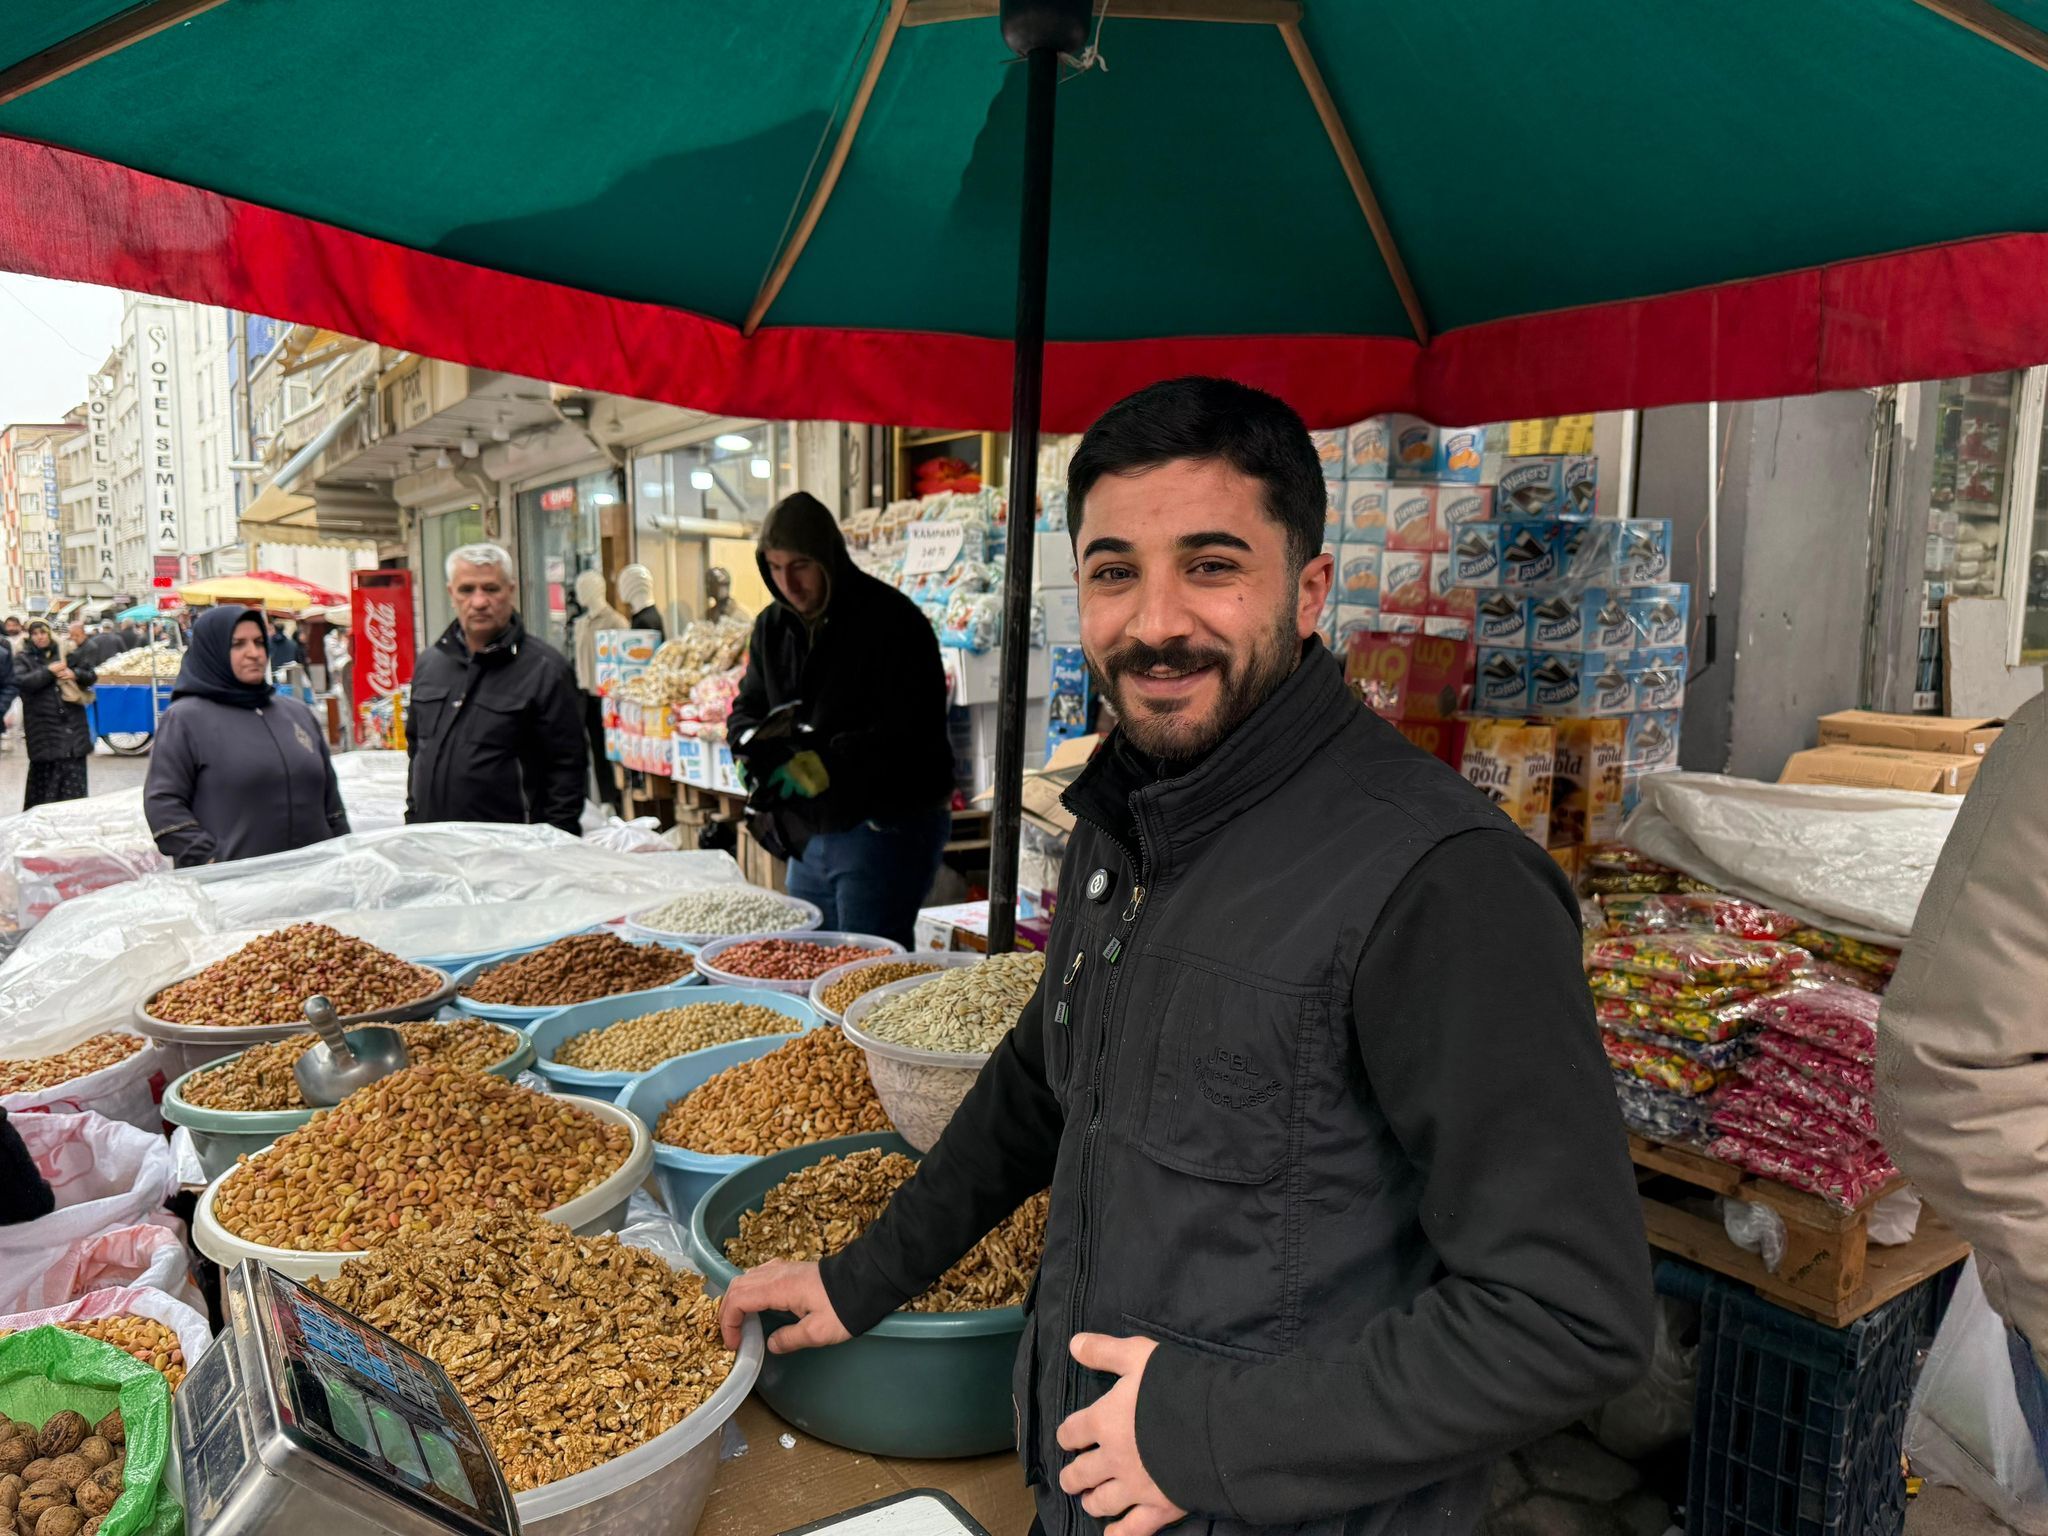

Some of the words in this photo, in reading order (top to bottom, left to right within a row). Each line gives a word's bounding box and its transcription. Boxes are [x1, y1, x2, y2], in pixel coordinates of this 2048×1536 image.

[151, 361, 169, 427] OTEL
[91, 401, 107, 464] OTEL
[1502, 465, 1549, 491] Wafers
[1485, 614, 1523, 635] Wafers
[1539, 616, 1580, 639] Wafers
[1554, 755, 1583, 775] old
[1598, 748, 1622, 766] gold
[1469, 765, 1512, 785] gold
[1528, 759, 1552, 777] gold
